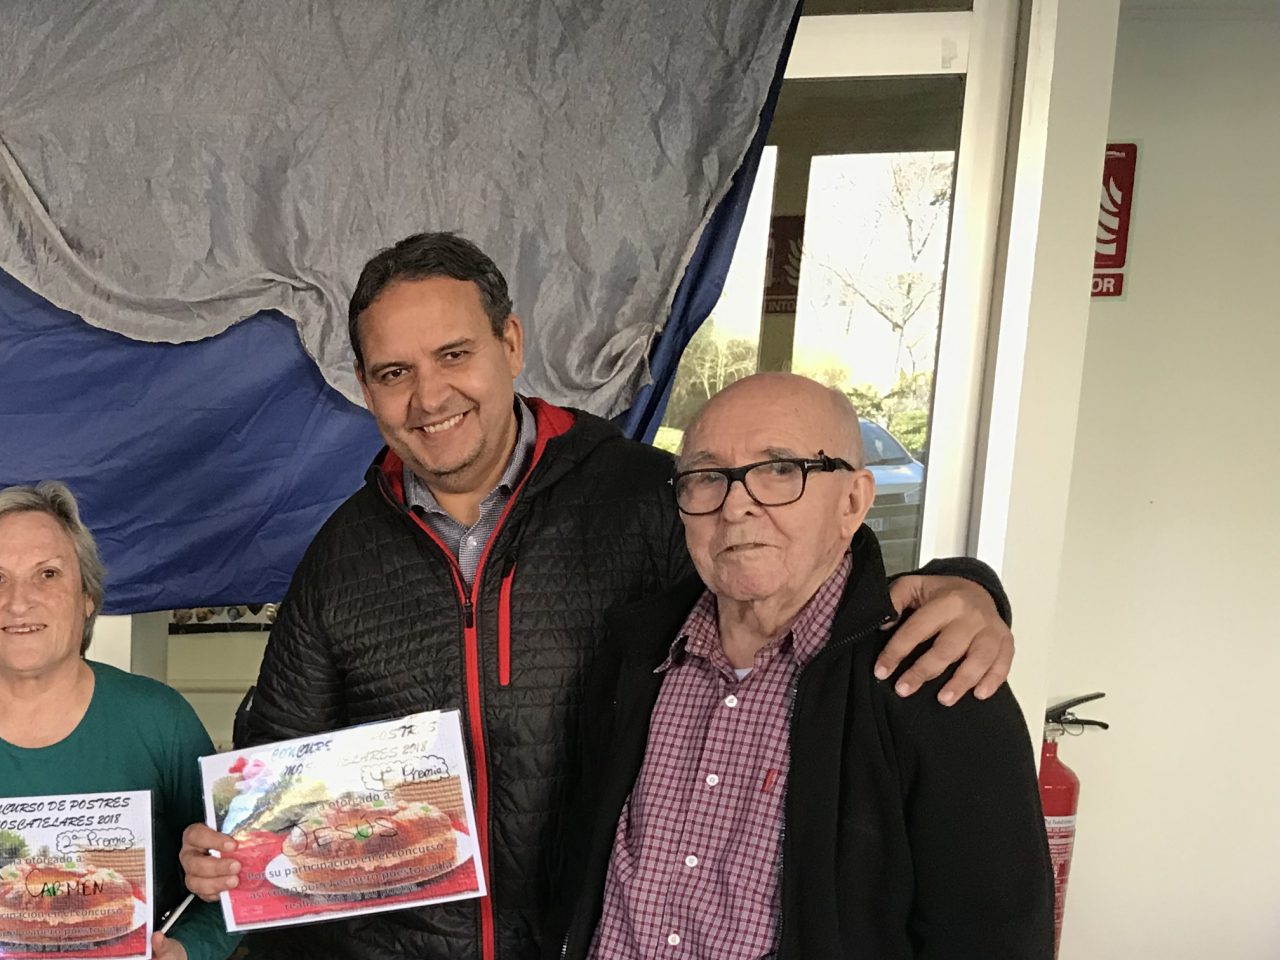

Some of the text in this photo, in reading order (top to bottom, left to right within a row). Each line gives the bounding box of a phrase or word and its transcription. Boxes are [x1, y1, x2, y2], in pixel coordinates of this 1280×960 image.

[47, 800, 67, 812] DE
[70, 797, 131, 811] POSTRES
[97, 813, 122, 826] 2018
[25, 854, 73, 865] otorgado
[269, 870, 281, 878] su
